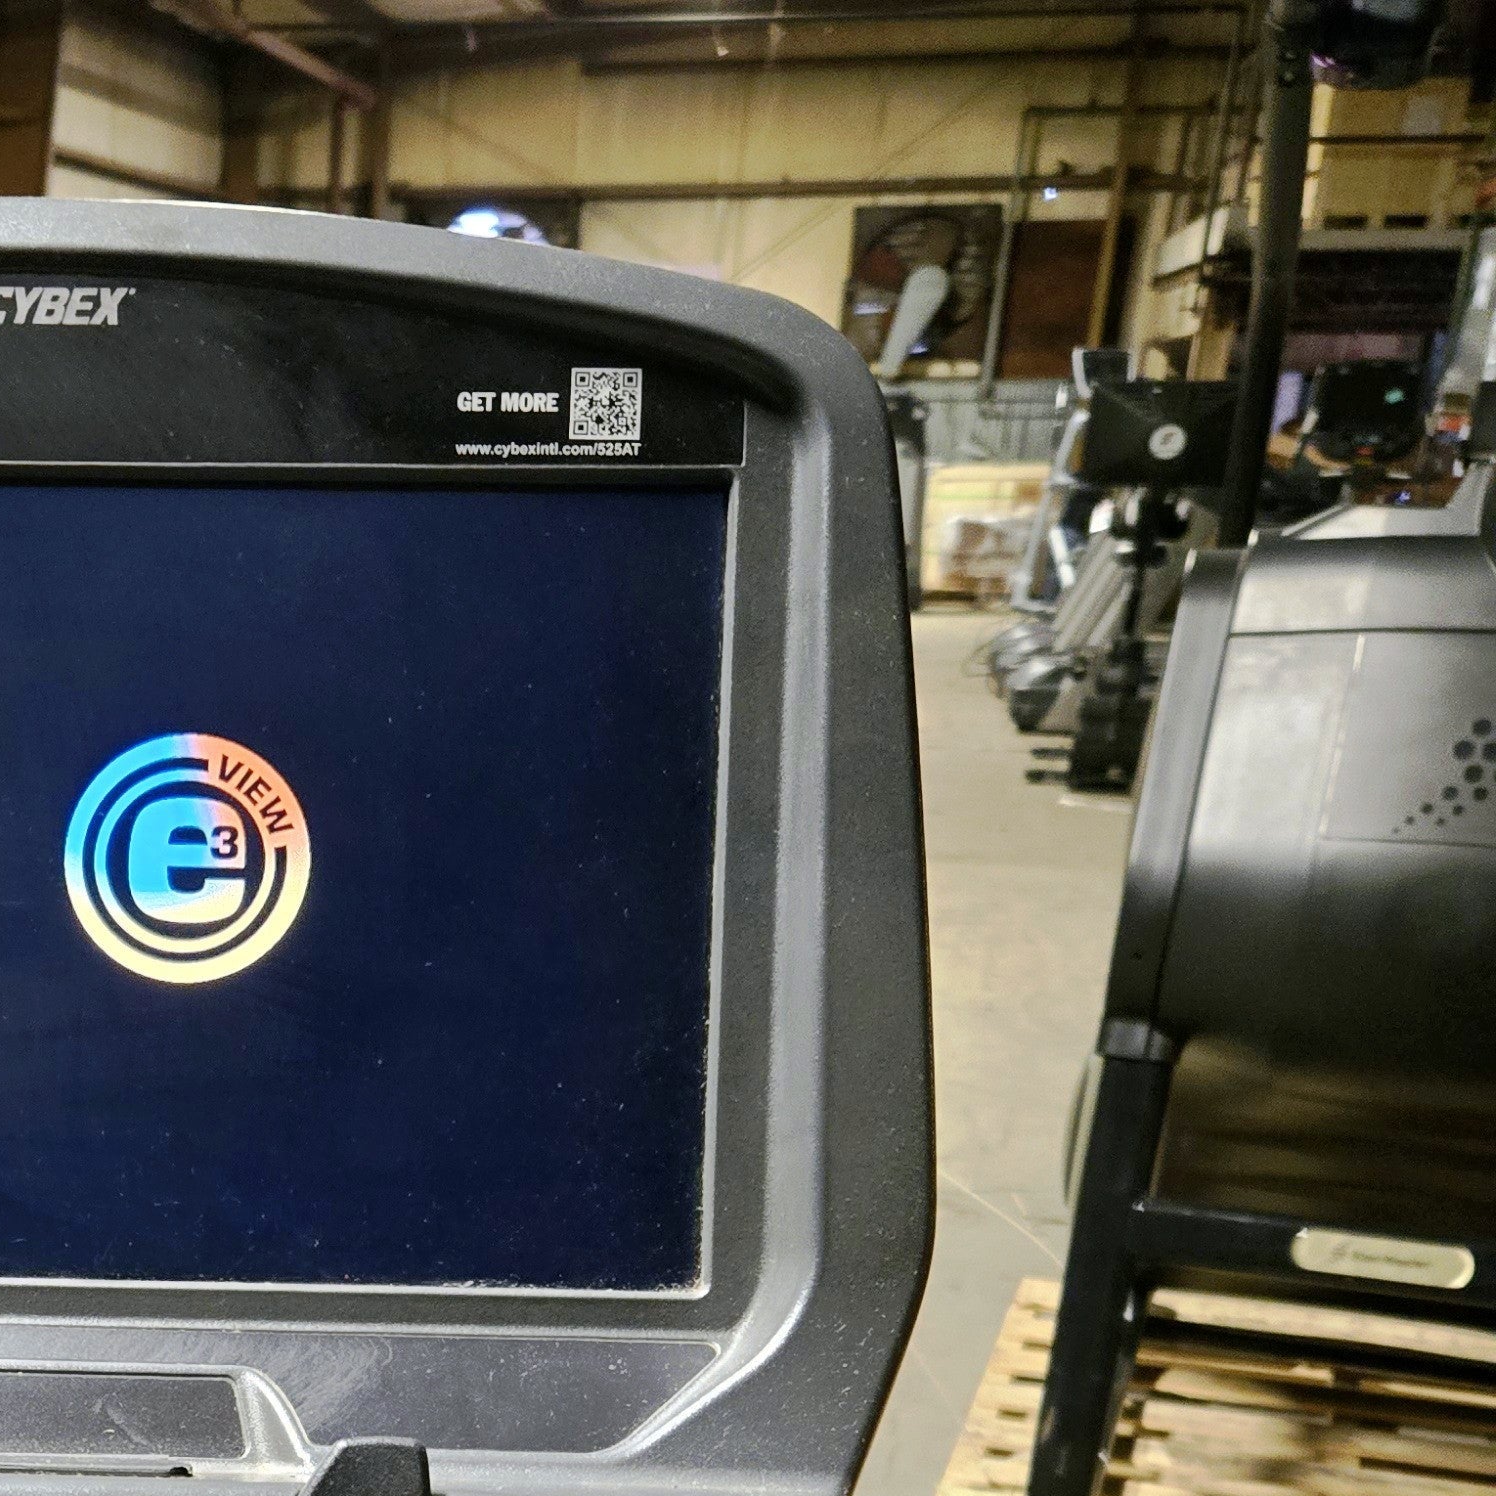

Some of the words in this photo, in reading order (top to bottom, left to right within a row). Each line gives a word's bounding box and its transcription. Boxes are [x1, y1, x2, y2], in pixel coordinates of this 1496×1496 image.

[457, 391, 497, 412] GET
[501, 392, 560, 413] MORE
[455, 441, 642, 459] www.cybexintl.com/525AT
[218, 753, 294, 835] VIEW
